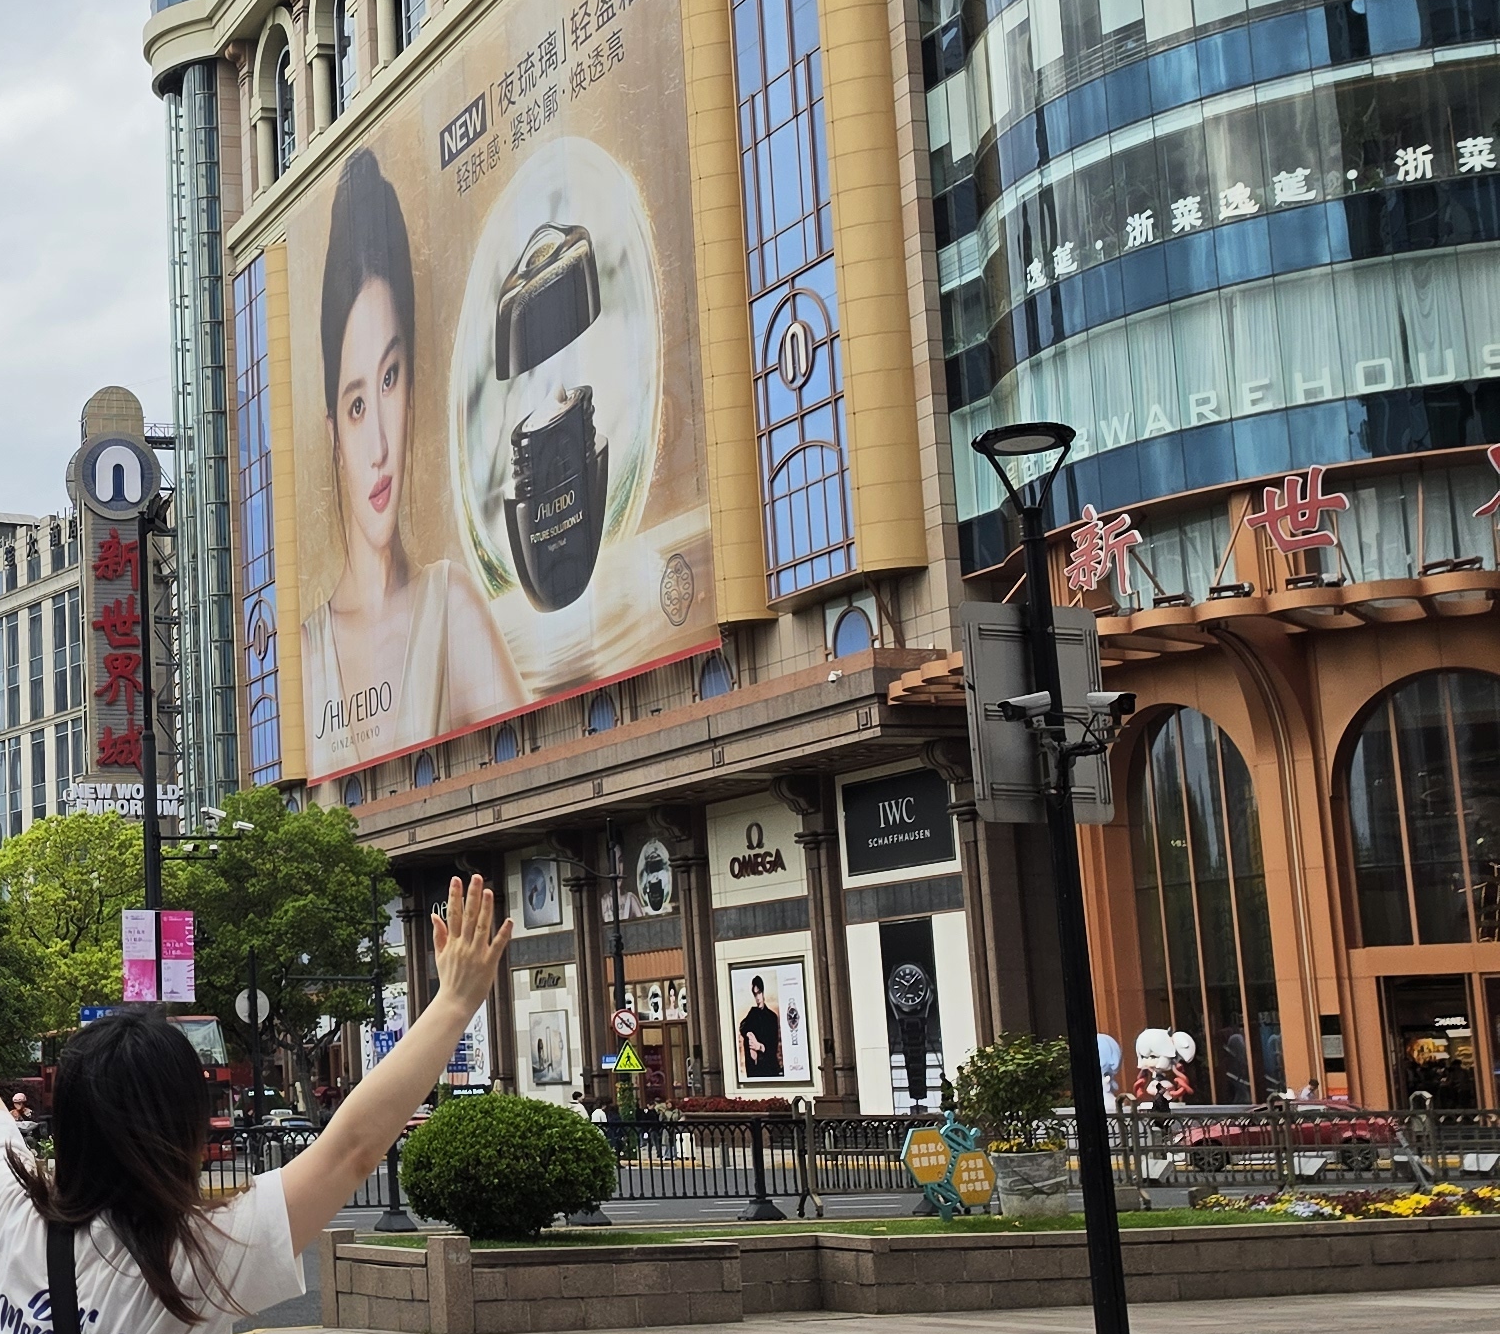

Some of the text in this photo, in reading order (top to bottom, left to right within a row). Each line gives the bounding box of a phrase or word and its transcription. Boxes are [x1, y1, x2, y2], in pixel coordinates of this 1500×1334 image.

[443, 99, 484, 162] NEW
[534, 490, 575, 523] SHISEIDO
[1064, 443, 1500, 596] 新世
[92, 527, 145, 772] 新世界城
[315, 681, 392, 740] SHISEIDO
[331, 725, 380, 753] GINZA TOKYO
[71, 783, 180, 799] NEW WOLD
[76, 800, 178, 816] EMPORM
[878, 796, 915, 828] IWC
[868, 829, 931, 848] SCHAFFHAUSEN
[730, 848, 786, 879] OMEGA
